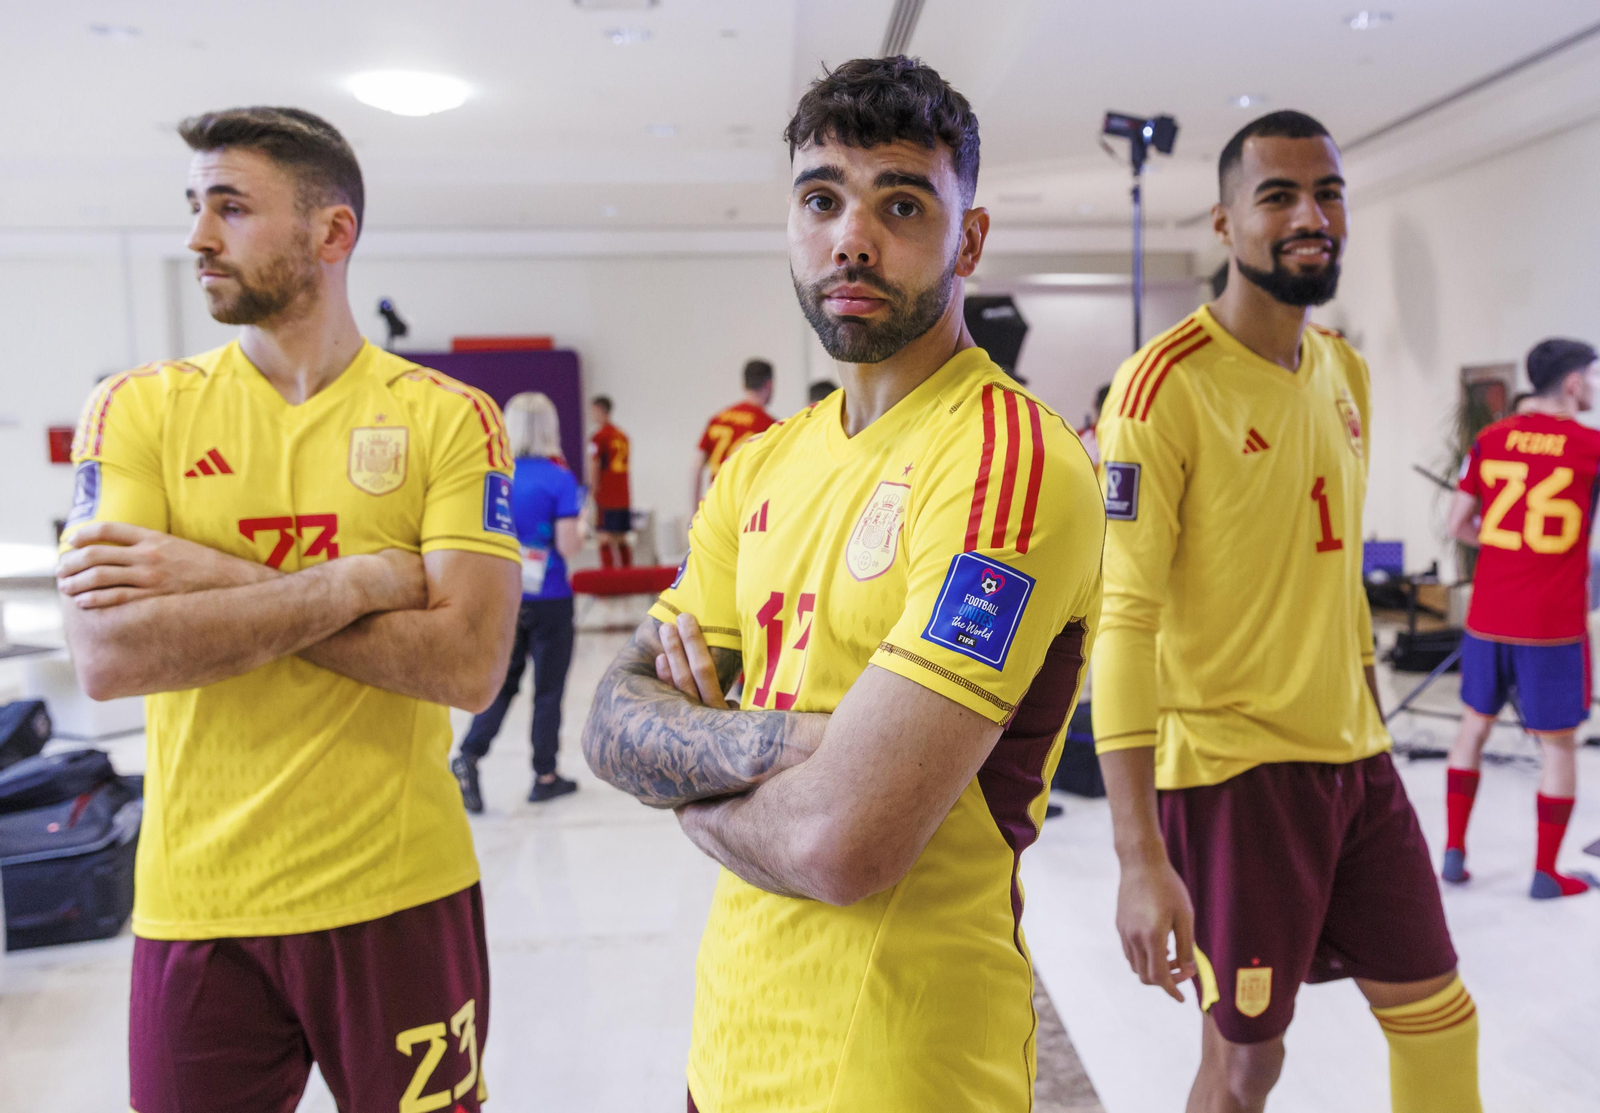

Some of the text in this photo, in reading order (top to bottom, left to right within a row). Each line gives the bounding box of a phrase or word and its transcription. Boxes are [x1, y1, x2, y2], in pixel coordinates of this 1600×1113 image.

[1310, 476, 1343, 553] 1
[1478, 459, 1583, 555] 26
[958, 603, 995, 629] UNITES
[963, 593, 999, 616] FOOTBALL
[951, 615, 994, 642] the World
[957, 634, 975, 646] FIFA
[395, 998, 479, 1113] 23
